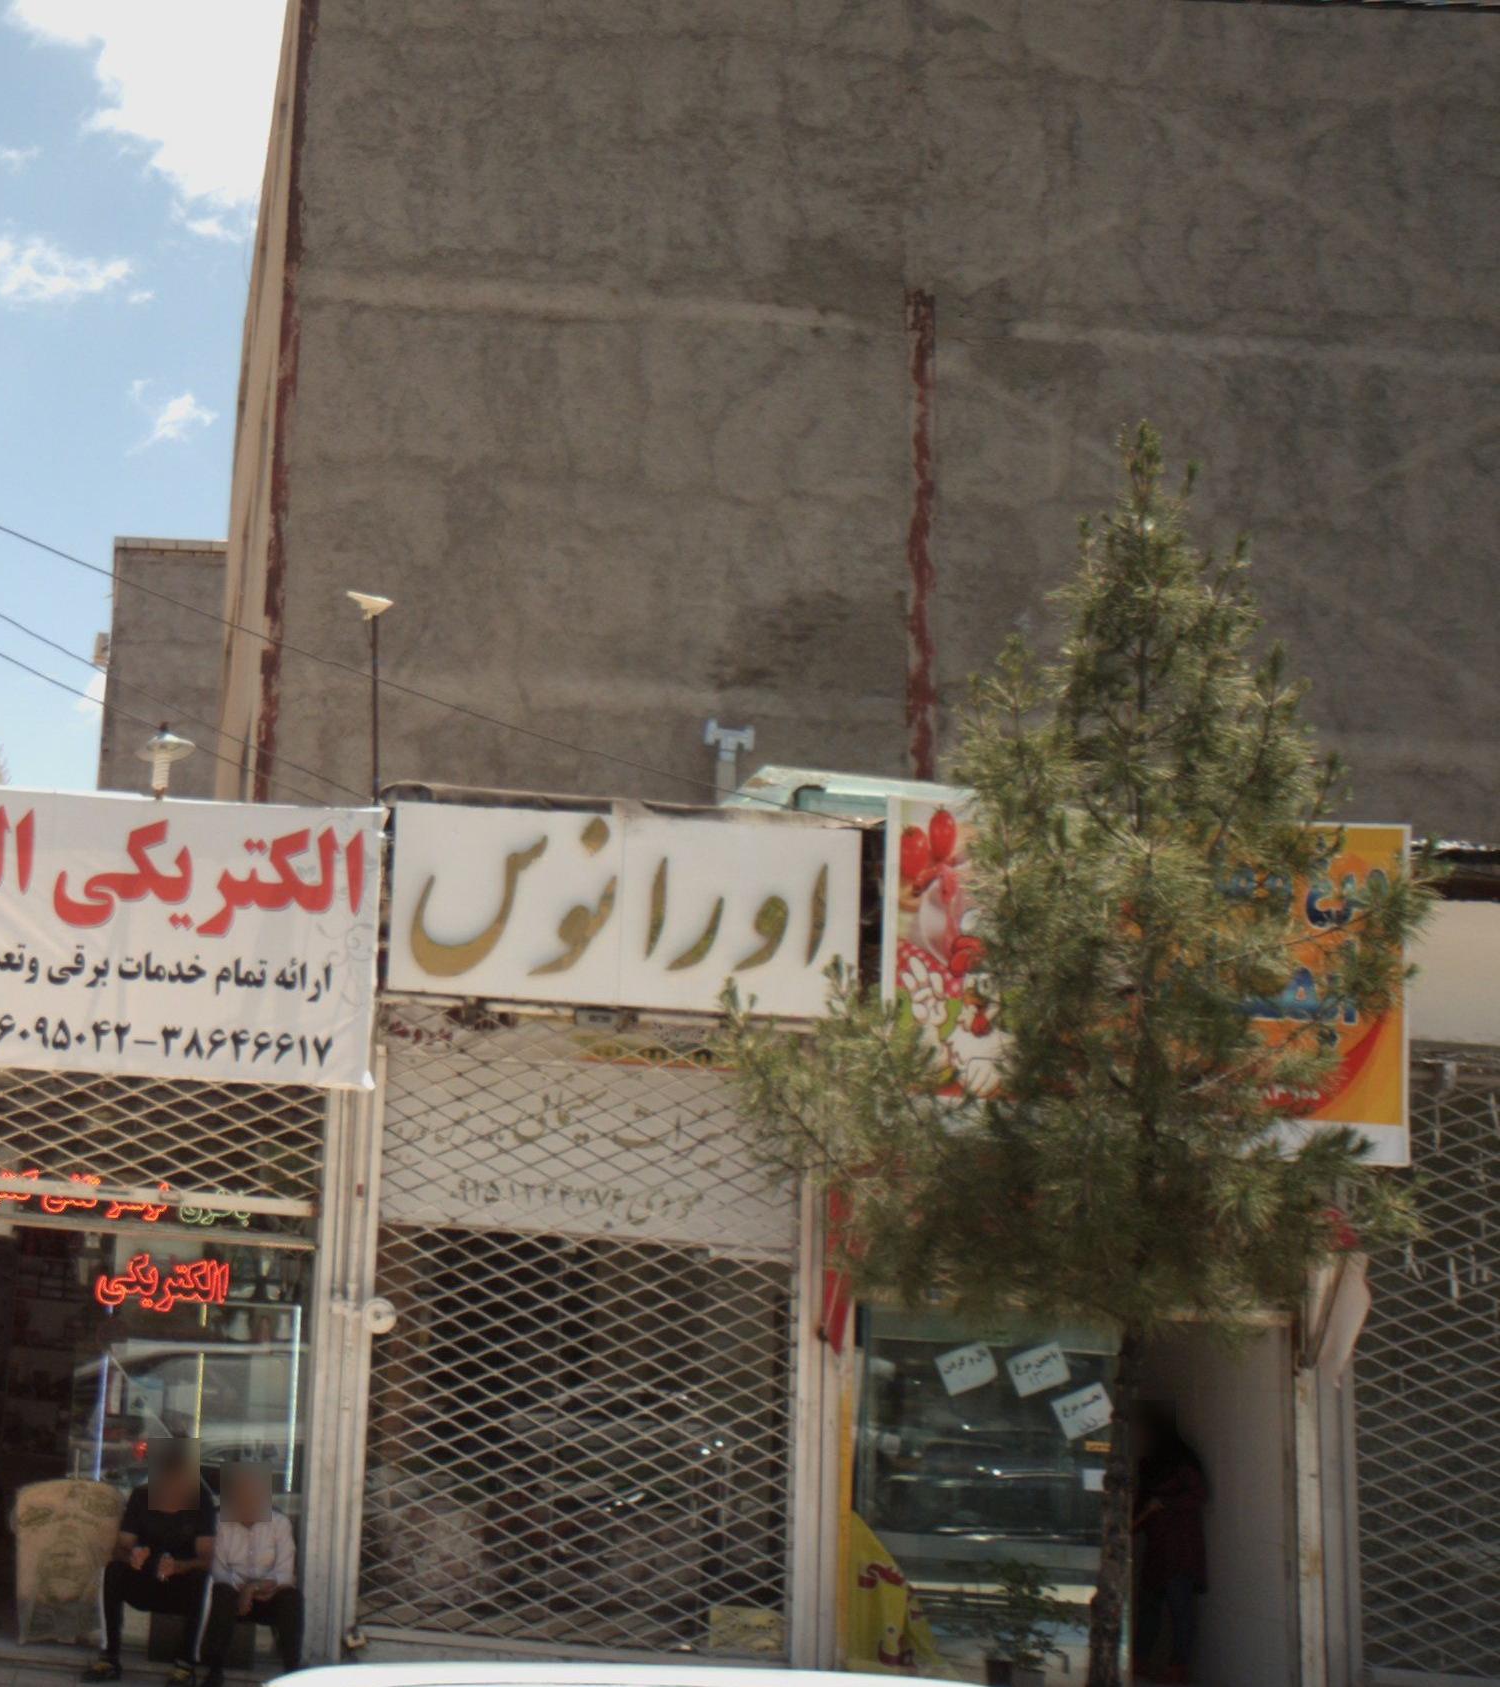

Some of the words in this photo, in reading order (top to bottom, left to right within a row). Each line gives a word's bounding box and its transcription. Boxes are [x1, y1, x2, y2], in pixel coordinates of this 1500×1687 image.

[52, 819, 365, 937] الکتریکی
[409, 815, 829, 979] اورانوس
[47, 944, 110, 989] برقی
[118, 952, 206, 982] خدمات
[215, 957, 268, 996] تمام
[274, 961, 332, 1002] ارائه
[95, 1250, 230, 1312] الکتریکی
